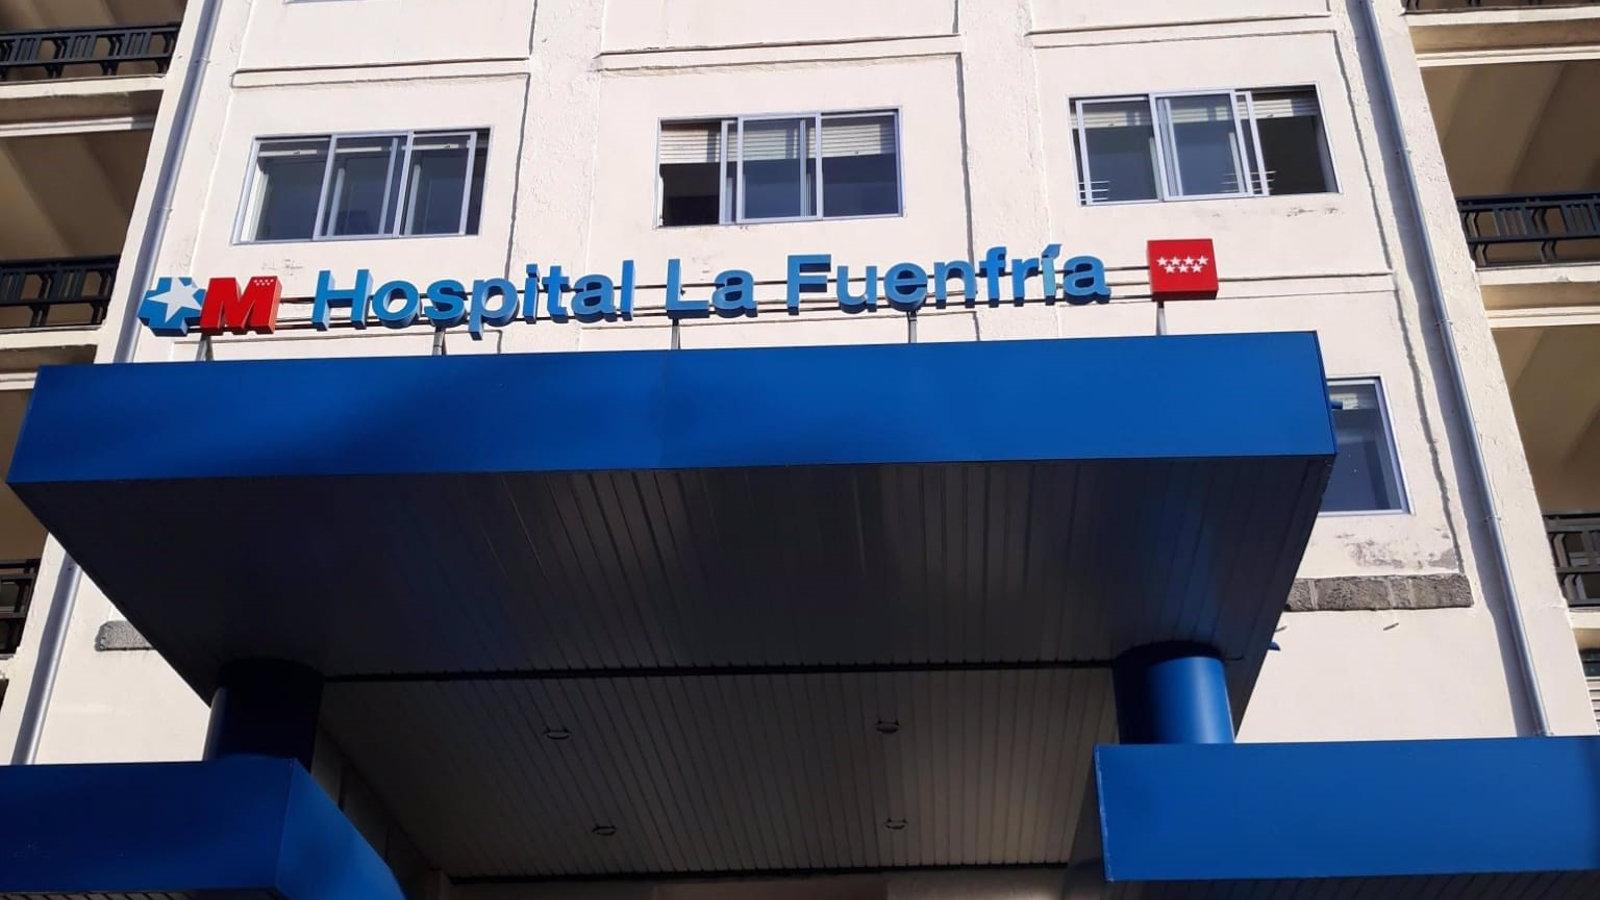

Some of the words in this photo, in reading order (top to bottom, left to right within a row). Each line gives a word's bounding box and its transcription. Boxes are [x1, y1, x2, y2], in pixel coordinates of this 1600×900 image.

[312, 260, 634, 340] Hospital
[666, 259, 757, 318] La
[787, 244, 1110, 314] Fuenfría
